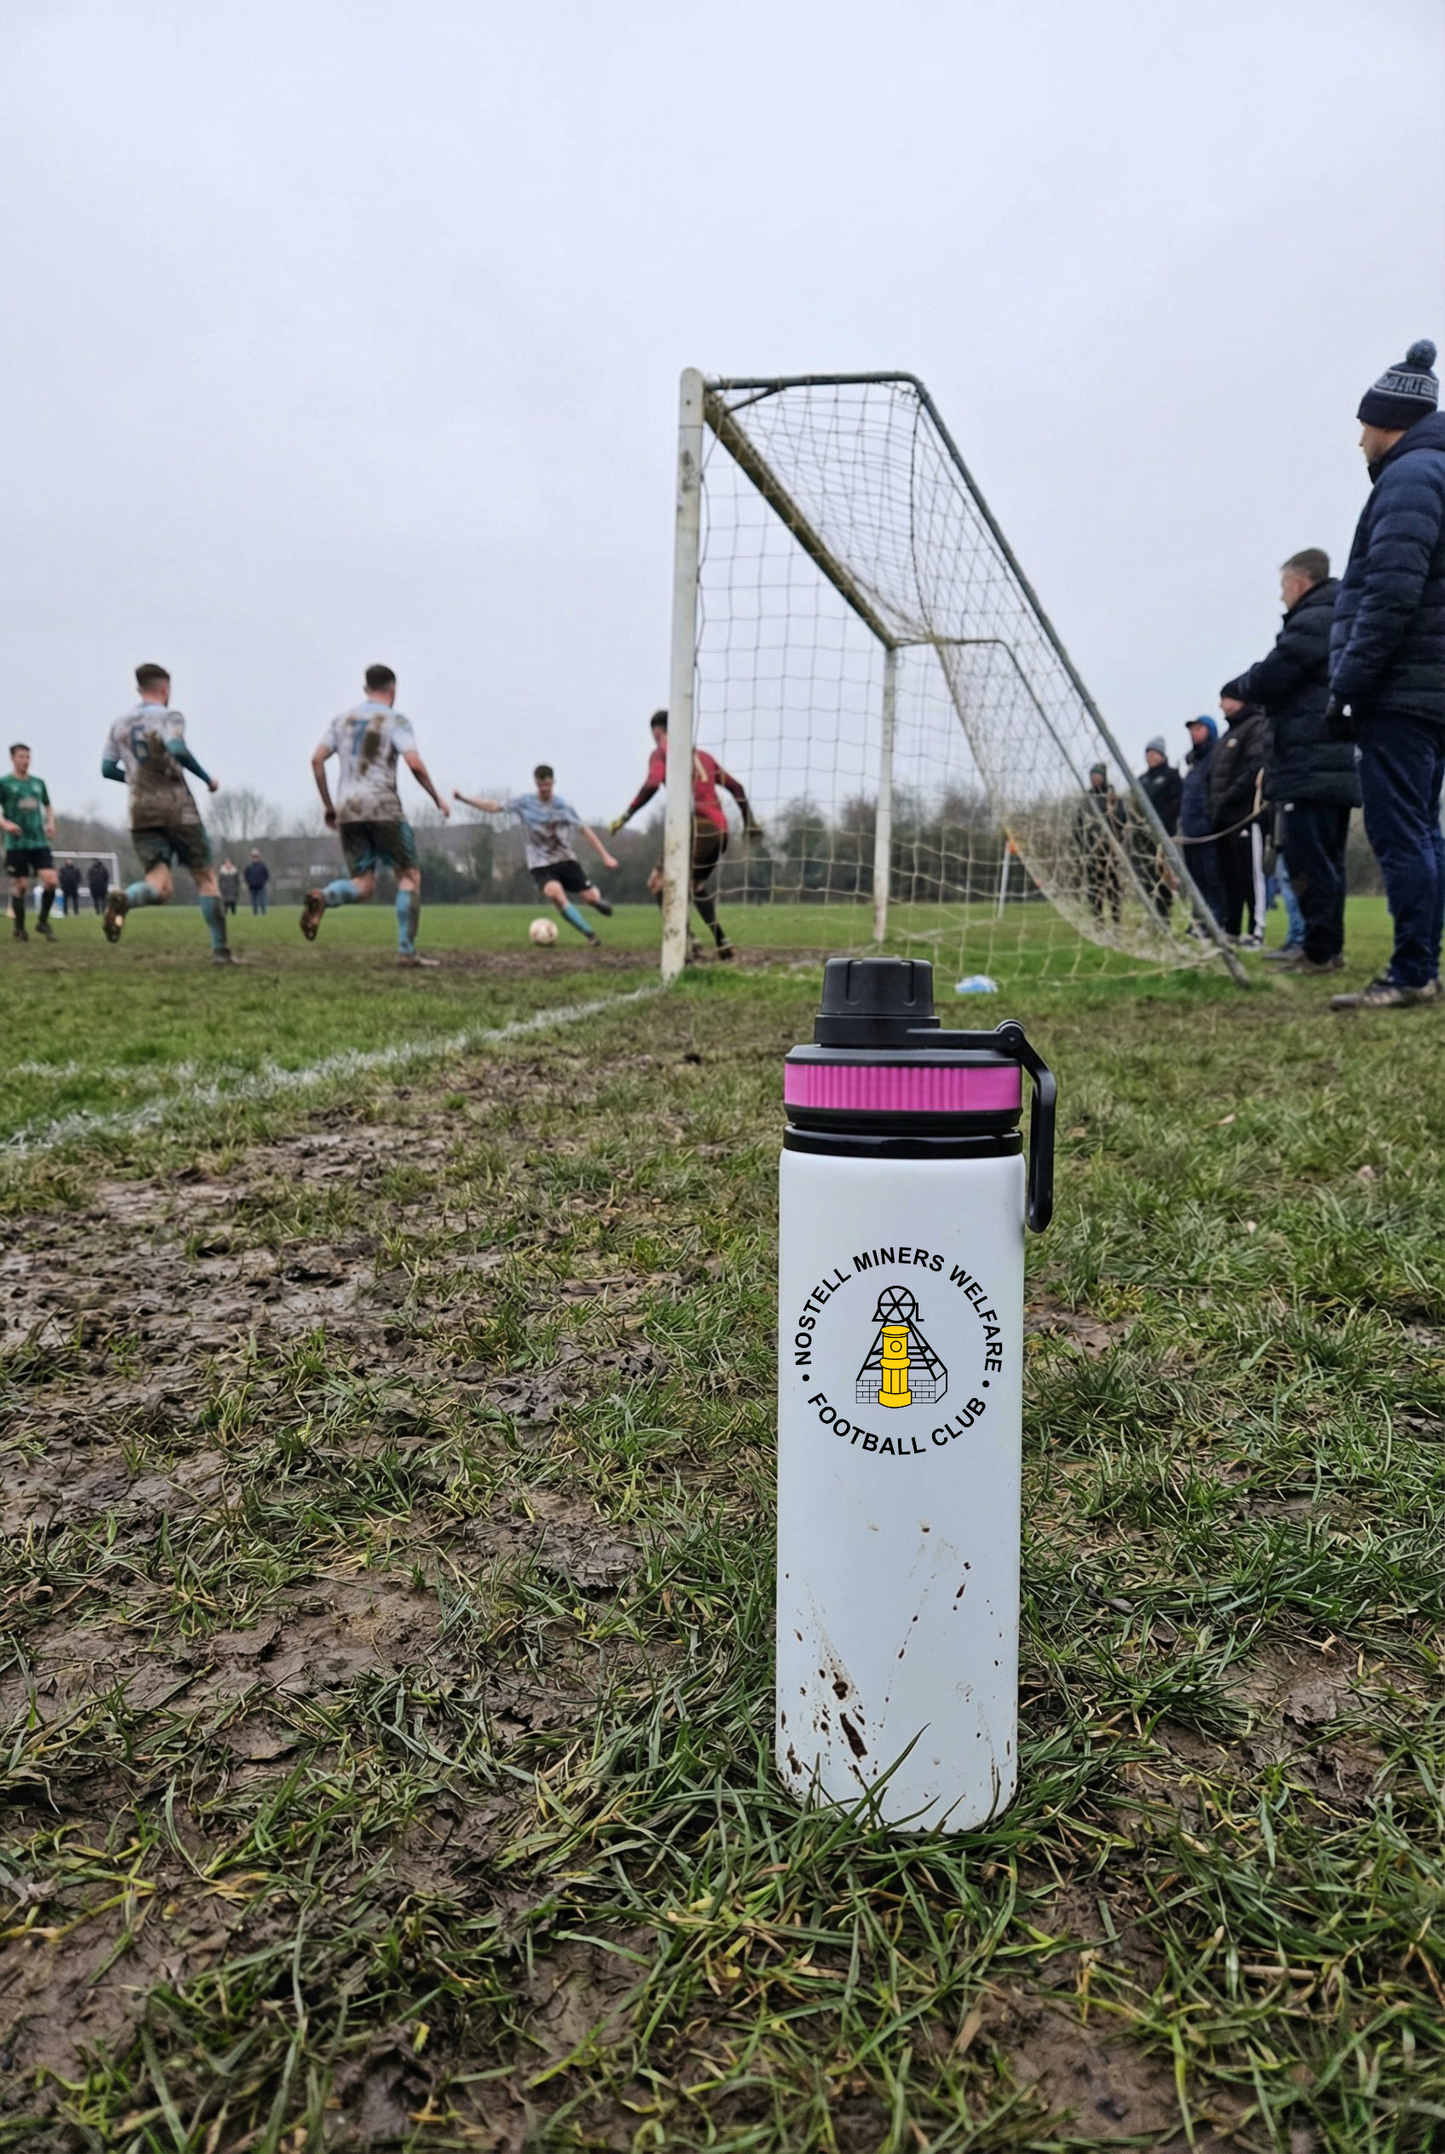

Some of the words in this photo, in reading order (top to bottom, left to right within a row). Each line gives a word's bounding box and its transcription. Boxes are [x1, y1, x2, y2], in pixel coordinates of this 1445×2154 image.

[130, 725, 150, 764] 6
[794, 1268, 852, 1366] NOSTELL
[852, 1246, 945, 1273] MINERS
[949, 1264, 1003, 1373] WELFARE
[807, 1392, 927, 1456] FOOTBALL
[931, 1397, 987, 1447] CLUB
